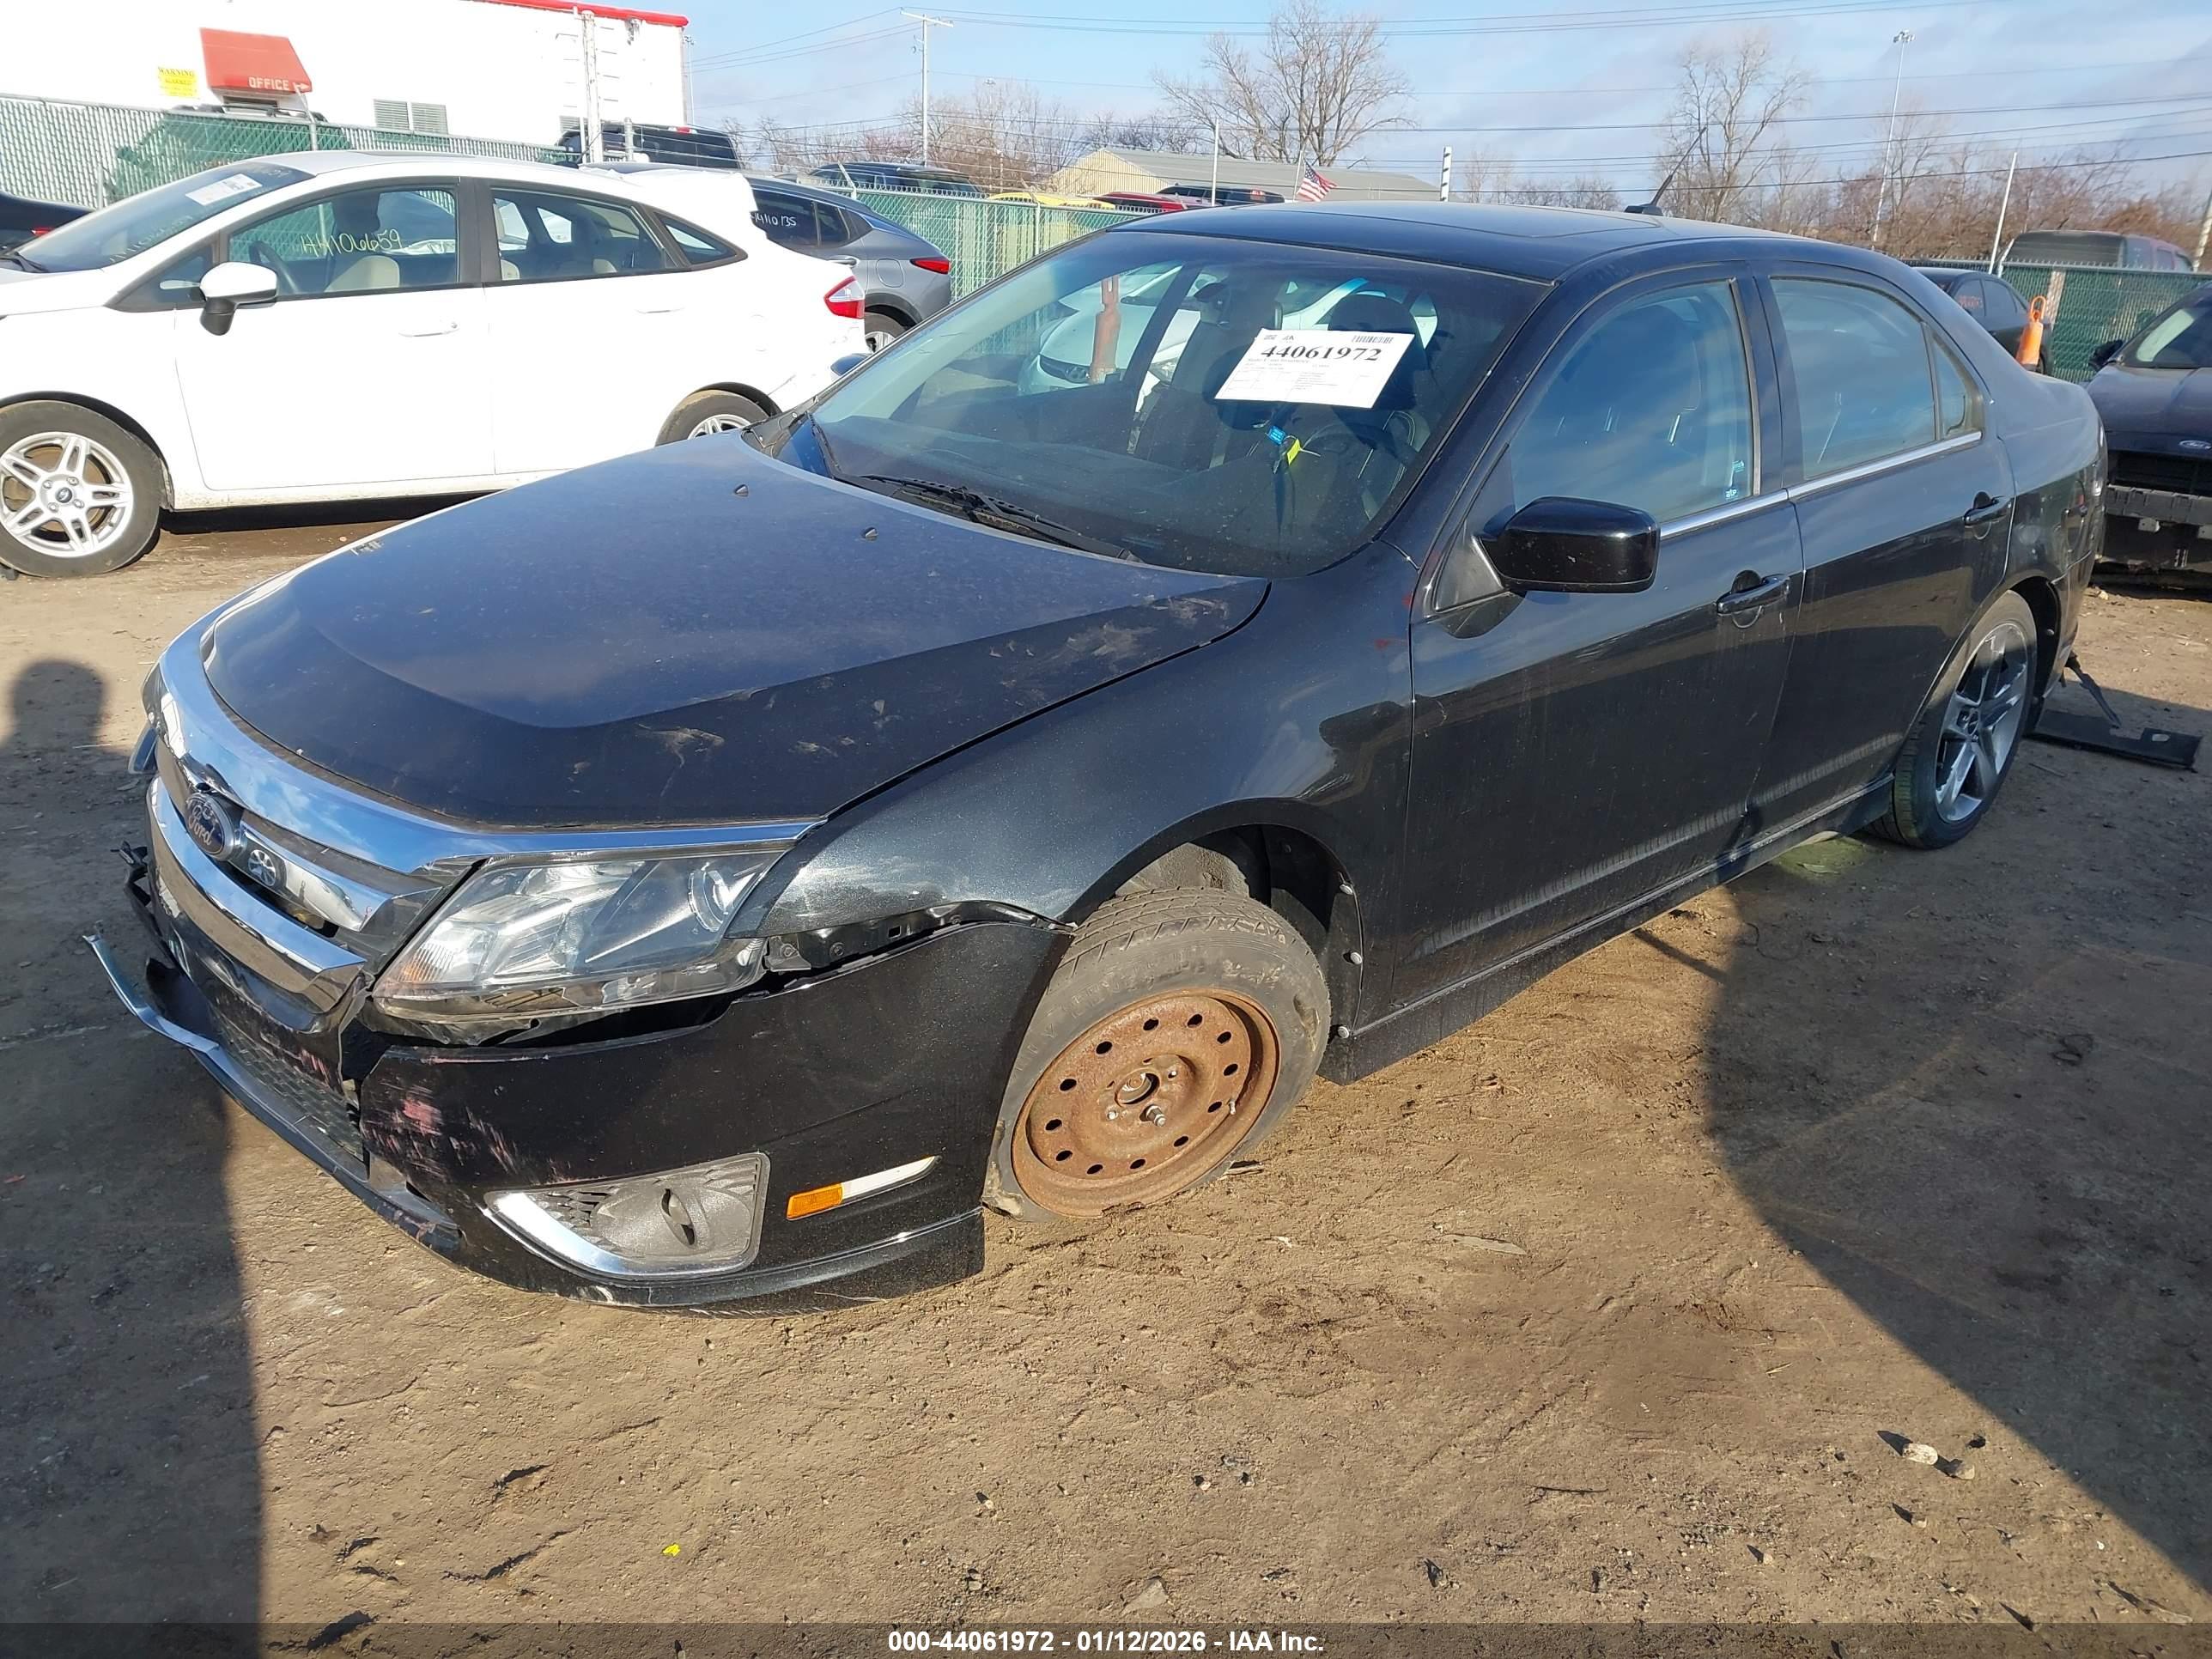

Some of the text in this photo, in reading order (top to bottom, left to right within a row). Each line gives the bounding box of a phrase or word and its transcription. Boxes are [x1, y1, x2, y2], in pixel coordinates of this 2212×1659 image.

[158, 66, 195, 77] WARNING
[248, 76, 290, 91] OFFICE
[1261, 345, 1382, 362] 44061972
[188, 805, 217, 846] Ford
